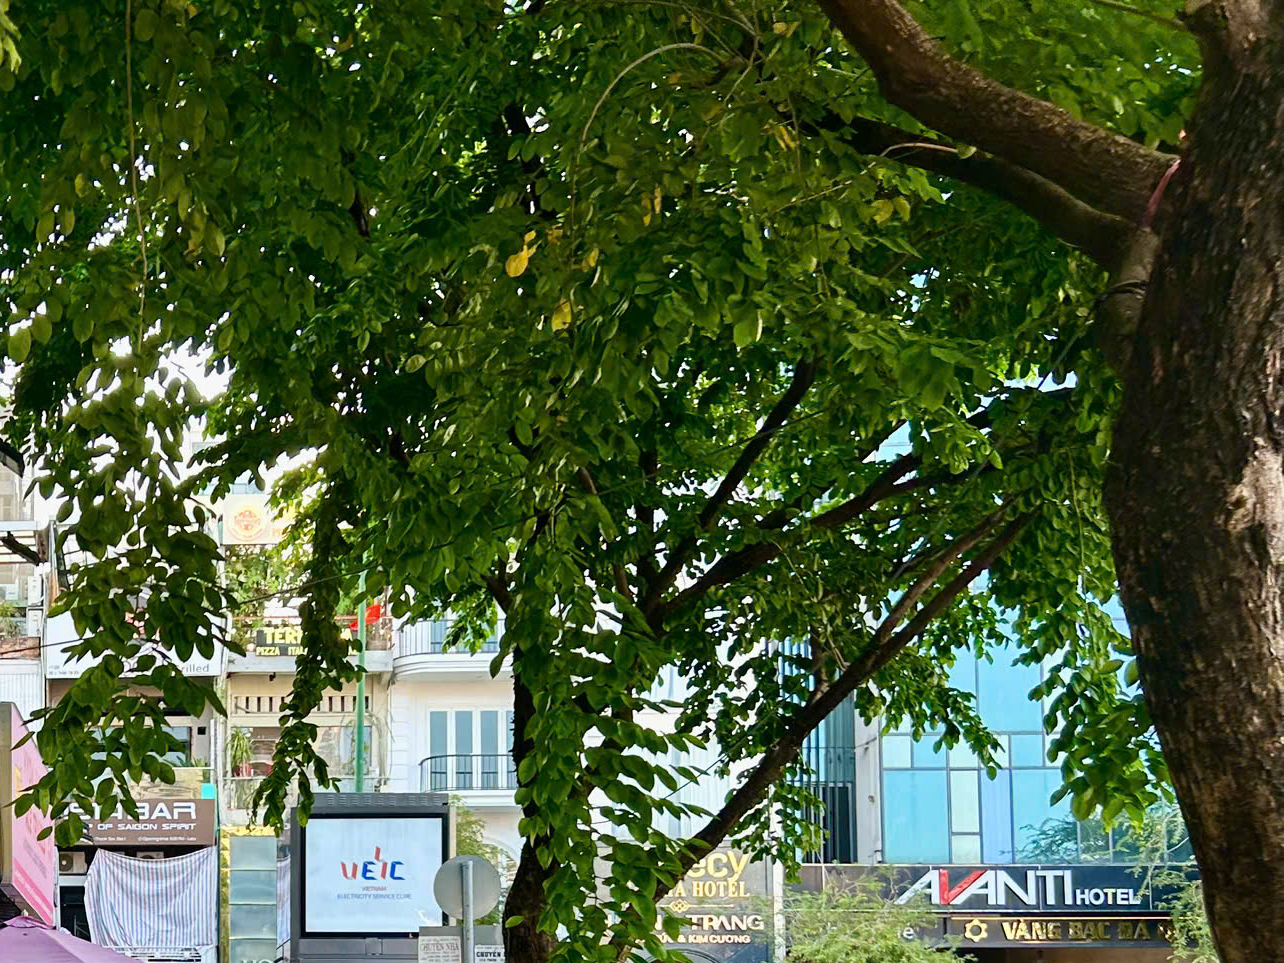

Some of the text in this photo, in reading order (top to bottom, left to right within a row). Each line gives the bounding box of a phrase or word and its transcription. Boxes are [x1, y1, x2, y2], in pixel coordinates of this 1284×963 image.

[256, 646, 281, 656] PIZZA
[180, 663, 211, 674] rilled
[97, 822, 197, 831] OF SAIGON SPIRIT
[692, 880, 750, 898] HOTEL
[893, 868, 1142, 906] AVANTI HOTEL
[685, 914, 765, 931] TRANG
[1001, 918, 1063, 940] VÀNG
[687, 934, 709, 943] KIM
